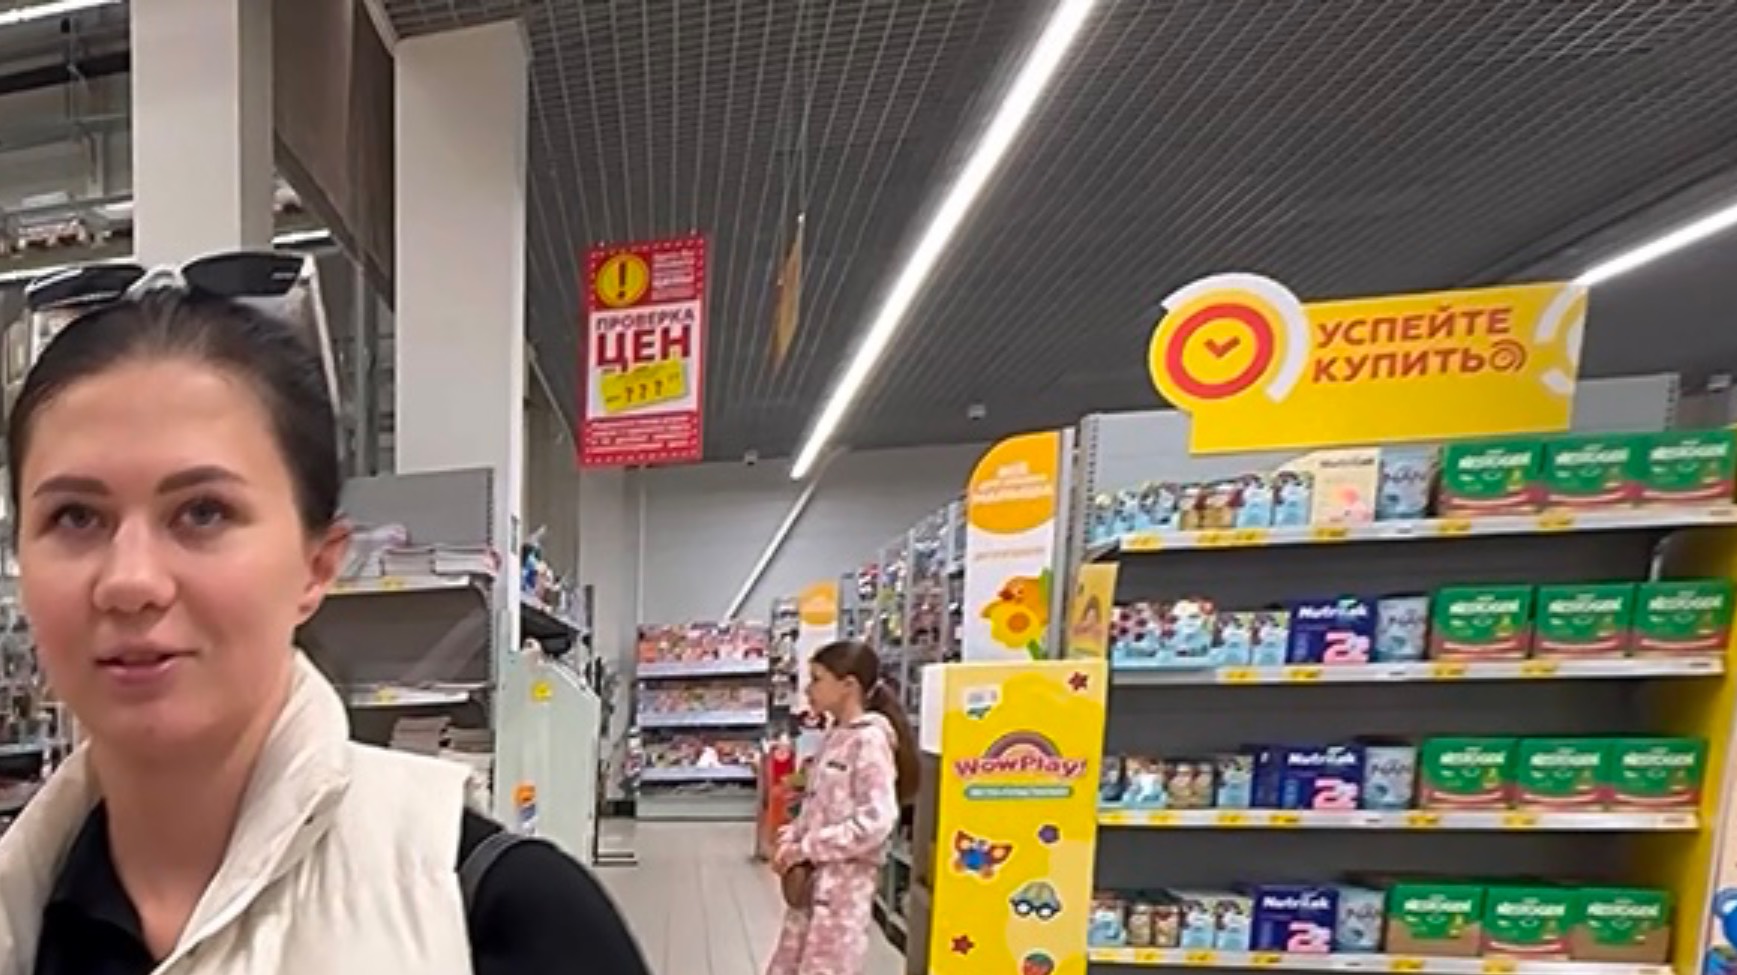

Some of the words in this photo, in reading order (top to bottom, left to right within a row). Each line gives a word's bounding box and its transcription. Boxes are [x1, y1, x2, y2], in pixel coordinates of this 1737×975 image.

[596, 308, 695, 332] ПРОВЕРКА
[1317, 306, 1513, 348] УСПЕЙТЕ
[596, 325, 691, 372] ЦЕН
[1311, 346, 1486, 384] КУПИТЬ
